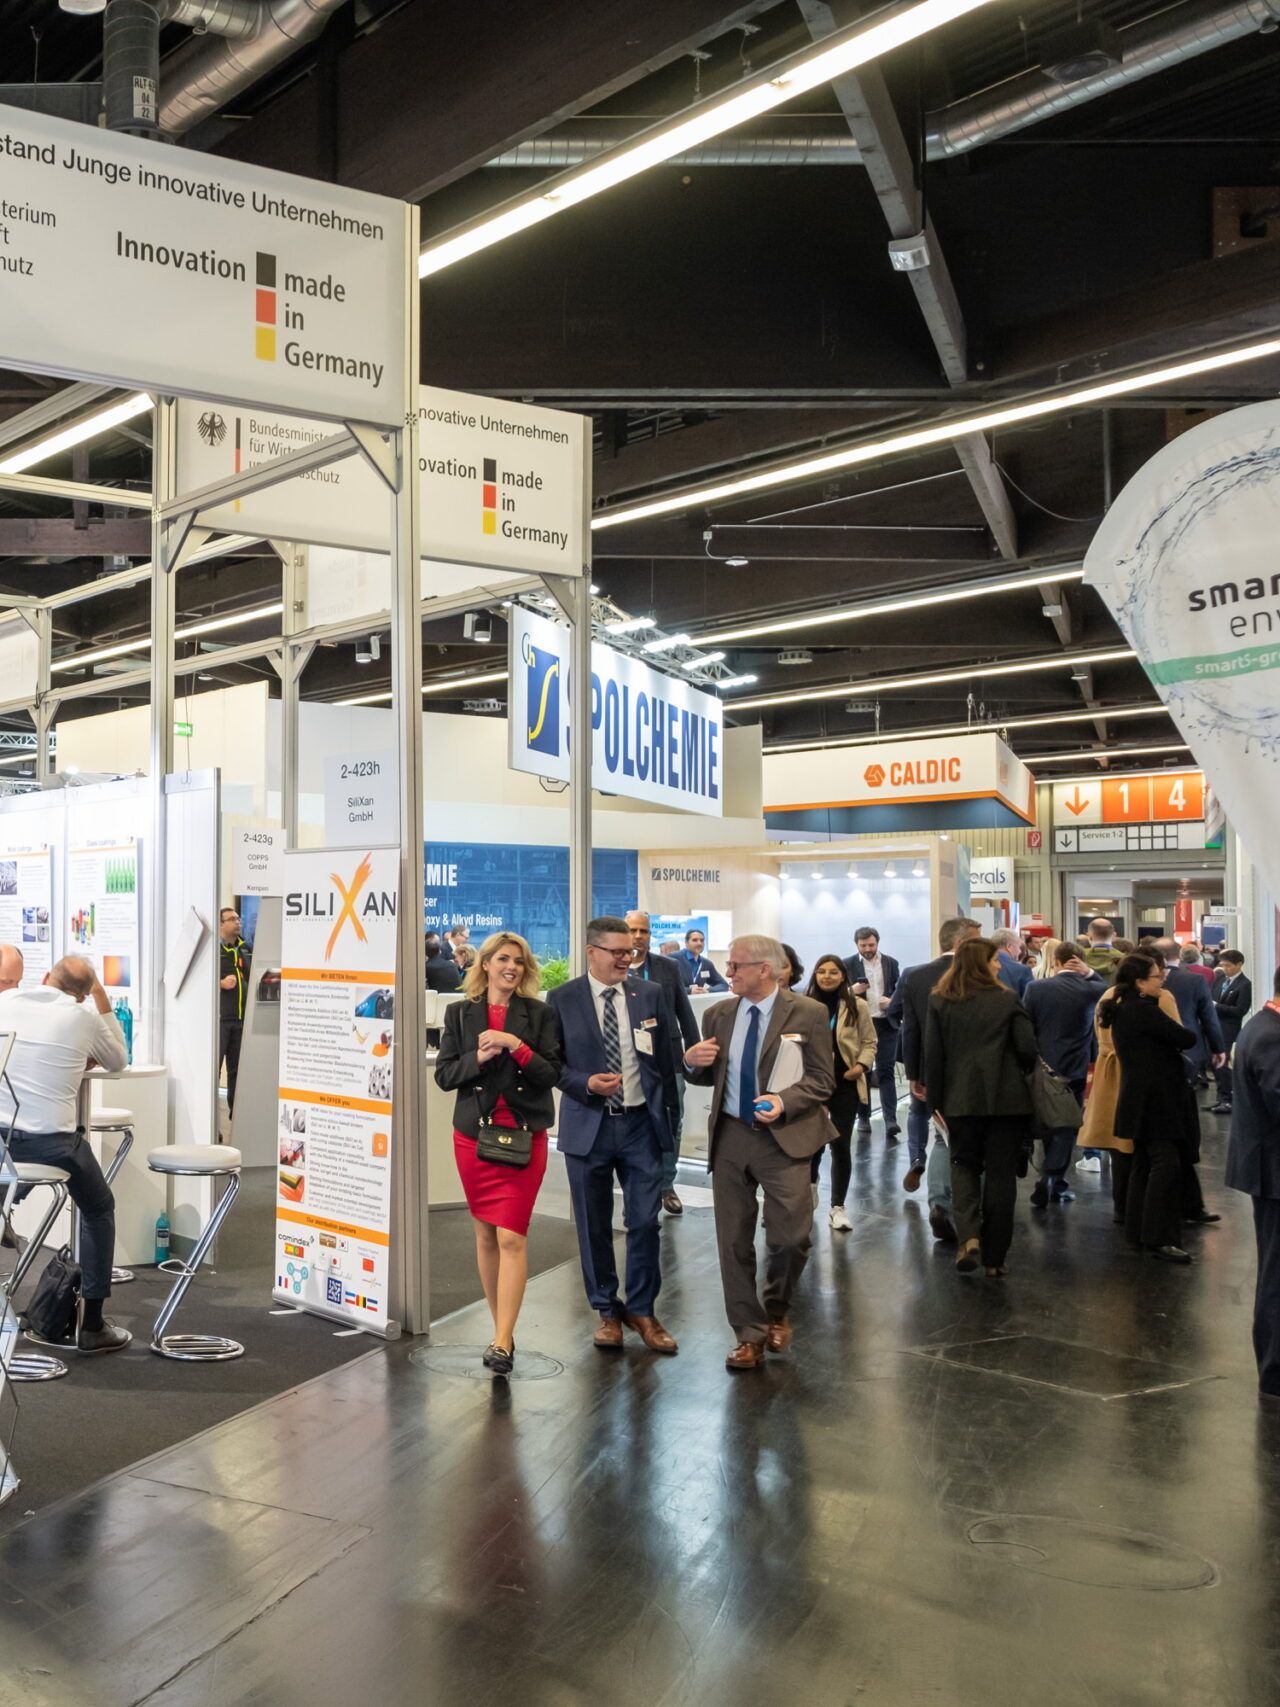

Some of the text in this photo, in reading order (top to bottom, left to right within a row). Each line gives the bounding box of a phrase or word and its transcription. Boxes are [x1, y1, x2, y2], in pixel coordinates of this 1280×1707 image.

[63, 148, 132, 184] Junge
[138, 165, 245, 208] innovative
[252, 191, 384, 240] Unternehmen
[117, 231, 246, 282] Innovation
[284, 270, 346, 302] made
[284, 303, 305, 331] in
[284, 342, 384, 389] Germany
[480, 415, 570, 445] Unternehmen
[249, 437, 265, 453] für
[502, 468, 543, 491] made
[502, 492, 515, 513] in
[502, 520, 569, 551] Germany
[567, 663, 719, 800] POLCHEMIE
[341, 760, 380, 779] 2-423h
[890, 757, 961, 786] CALDIC
[347, 797, 374, 808] SiliXan
[1118, 779, 1187, 814] 1 4
[349, 811, 373, 823] GmbH
[243, 833, 273, 845] 2-423g
[1081, 831, 1111, 840] Service
[249, 863, 268, 871] GmbH
[424, 863, 458, 887] MIE
[663, 868, 721, 883] SPOLCHEMIE
[425, 913, 503, 928] oxy & Alkyd Resins
[278, 1232, 310, 1247] comindex
